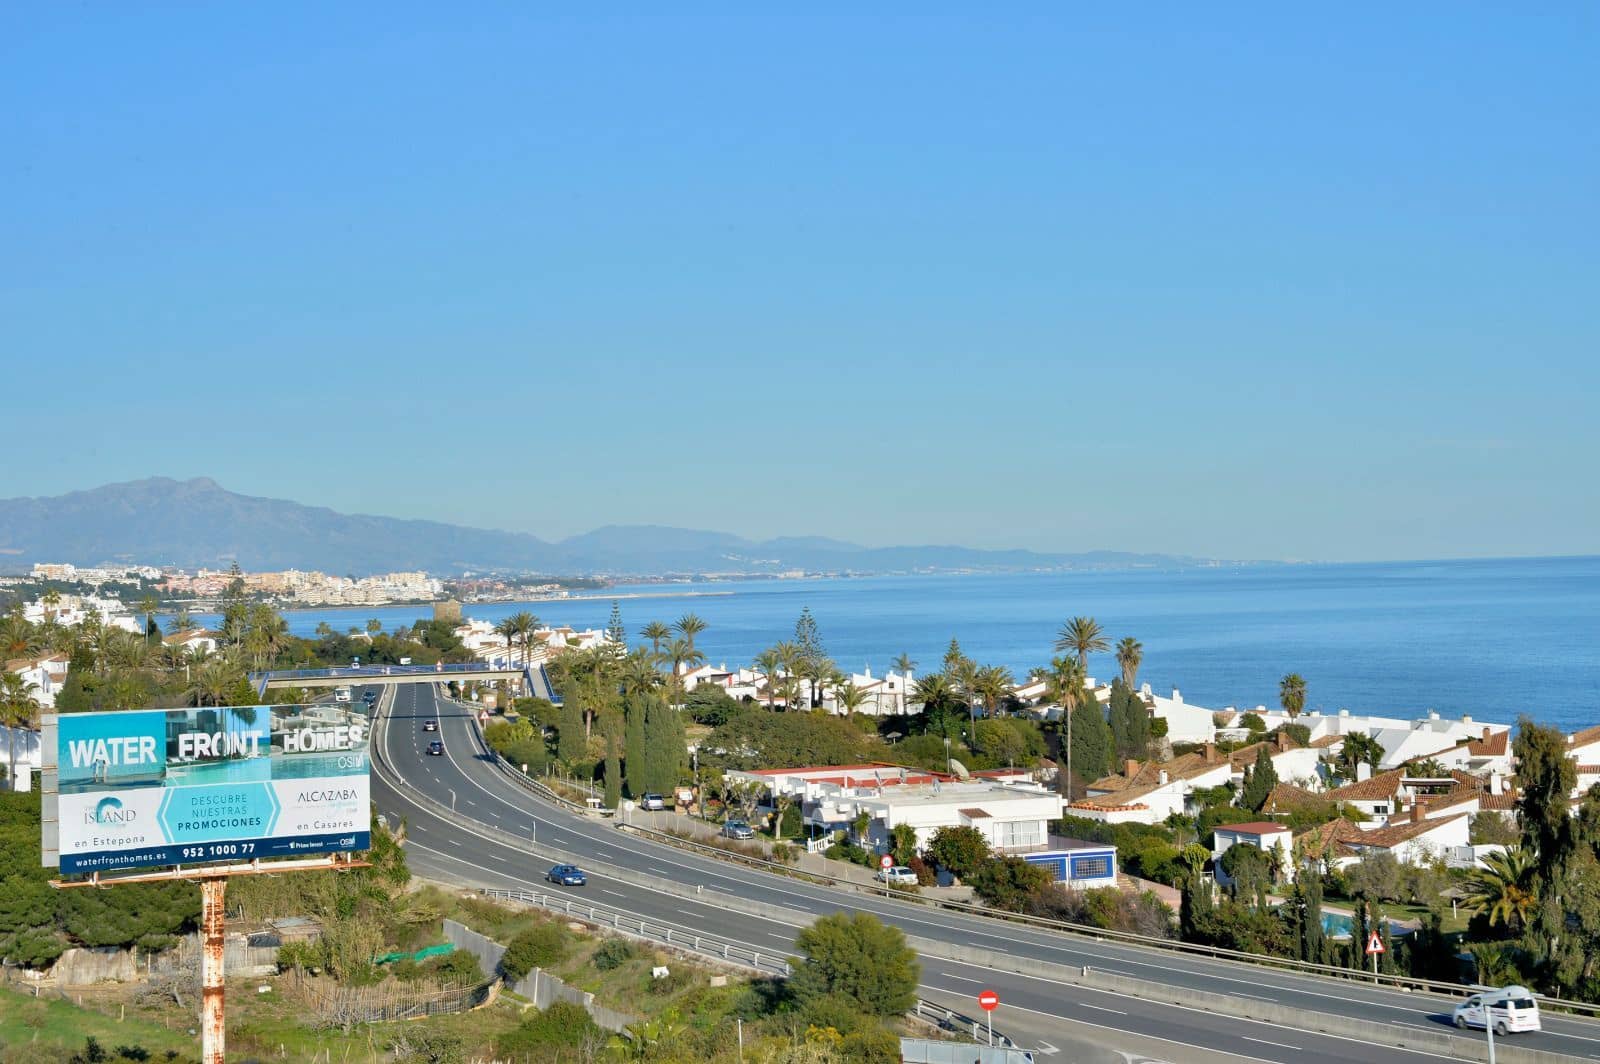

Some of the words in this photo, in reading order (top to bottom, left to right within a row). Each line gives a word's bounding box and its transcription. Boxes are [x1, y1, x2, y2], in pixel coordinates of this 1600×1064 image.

[68, 735, 157, 768] WATER
[178, 731, 263, 759] FRONT
[282, 726, 363, 753] HOMES
[191, 793, 247, 806] DESCUBRE
[297, 789, 358, 803] ALCAZABA
[191, 806, 247, 818] NUESTRAS
[177, 817, 261, 831] PROMOCIONES
[297, 823, 309, 831] en
[313, 820, 354, 830] Casares
[74, 840, 88, 848] en
[93, 835, 145, 848] Estepona
[182, 847, 204, 858] 952
[209, 844, 237, 855] 1000
[241, 843, 255, 853] 77
[75, 854, 167, 867] waterfronthomes.es
